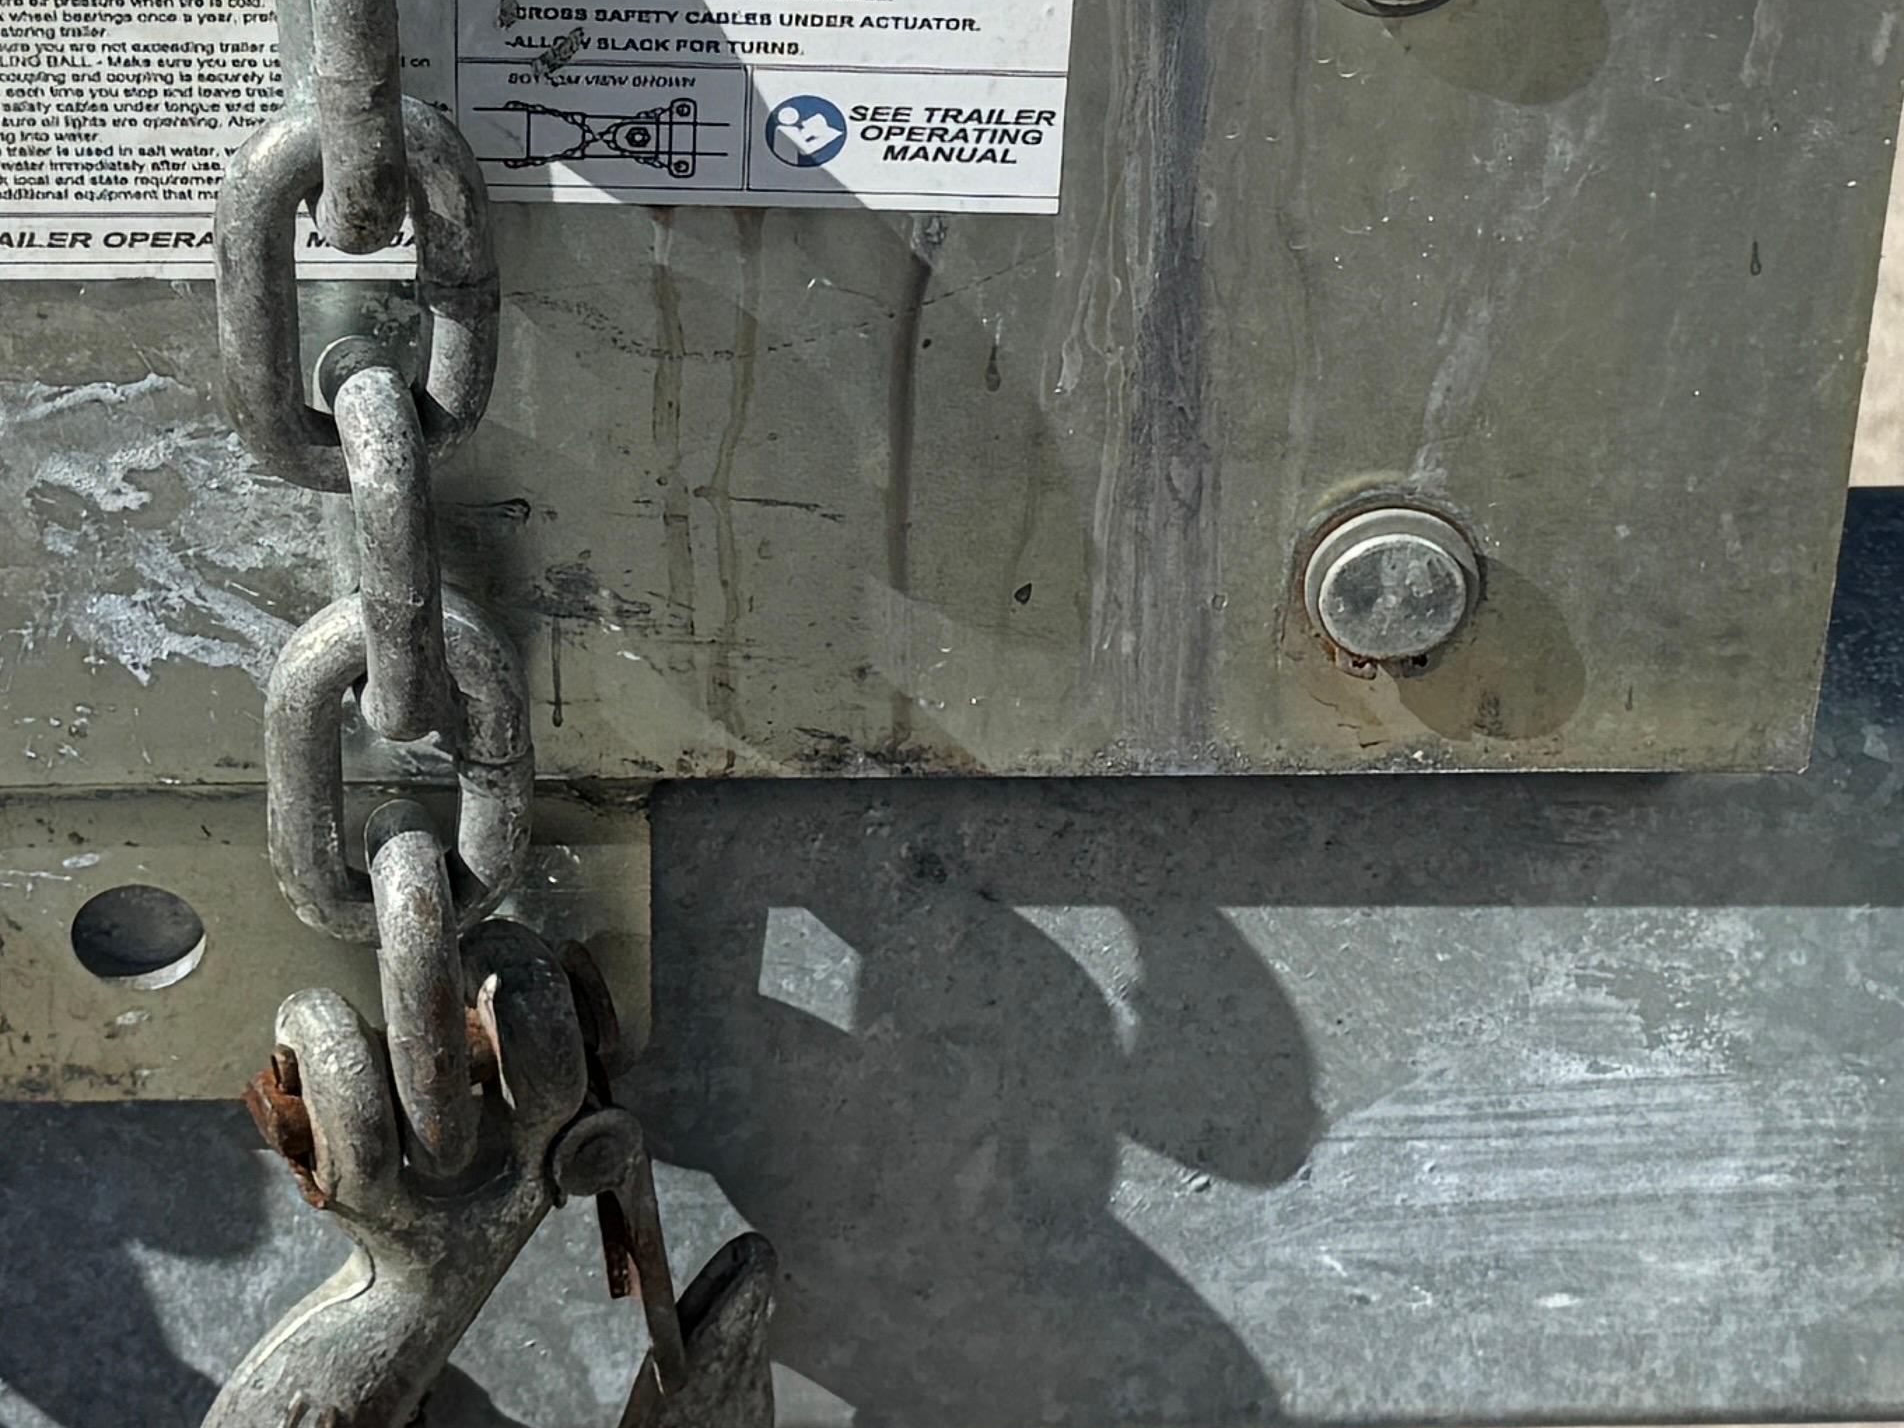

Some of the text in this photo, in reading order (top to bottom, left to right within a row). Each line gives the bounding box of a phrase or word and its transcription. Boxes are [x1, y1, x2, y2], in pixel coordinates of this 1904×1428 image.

[8, 10, 57, 22] wheel
[62, 10, 132, 25] bearings
[137, 12, 177, 22] once
[594, 8, 679, 24] SAFETY
[684, 10, 772, 26] CABLES
[778, 13, 855, 29] UNDER
[859, 15, 982, 32] ACTUATOR.
[0, 26, 55, 39] storing
[35, 42, 65, 54] you
[70, 43, 96, 53] are
[101, 42, 127, 53] not
[131, 41, 215, 55] exceeding
[219, 42, 265, 53] trailer
[596, 36, 670, 52] SLACK
[675, 40, 720, 54] FOR
[47, 55, 92, 68] BALL
[108, 56, 151, 68] Make
[157, 57, 193, 68] sure
[197, 58, 227, 69] you
[231, 58, 258, 68] are
[71, 71, 102, 83] and
[106, 73, 174, 85] coupling
[197, 72, 264, 85] securely
[584, 74, 697, 88] VIEW SHOWN
[6, 86, 45, 98] each
[50, 86, 84, 98] time
[89, 87, 119, 99] you
[123, 87, 158, 99] stop
[163, 87, 193, 98] and
[198, 87, 242, 98] leave
[2, 101, 52, 114] safety
[56, 101, 109, 113] cables
[113, 101, 159, 113] under
[164, 101, 221, 115] tongue
[225, 101, 256, 113] and
[849, 105, 1057, 126] SEE TRAILER
[1, 116, 37, 128] sure
[64, 116, 107, 130] lights
[112, 117, 138, 128] are
[20, 131, 50, 142] into
[860, 125, 1044, 146] OPERATING
[7, 145, 52, 157] trailer
[75, 145, 114, 157] used
[138, 145, 166, 157] salt
[882, 145, 1017, 165] MANUAL
[0, 160, 45, 172] water
[49, 159, 146, 173] immediately
[151, 160, 186, 172] after
[13, 174, 50, 186] local
[55, 175, 85, 186] and
[89, 175, 129, 186] state
[73, 188, 159, 202] equipment
[163, 189, 193, 201] that
[103, 232, 213, 249] OPERA
